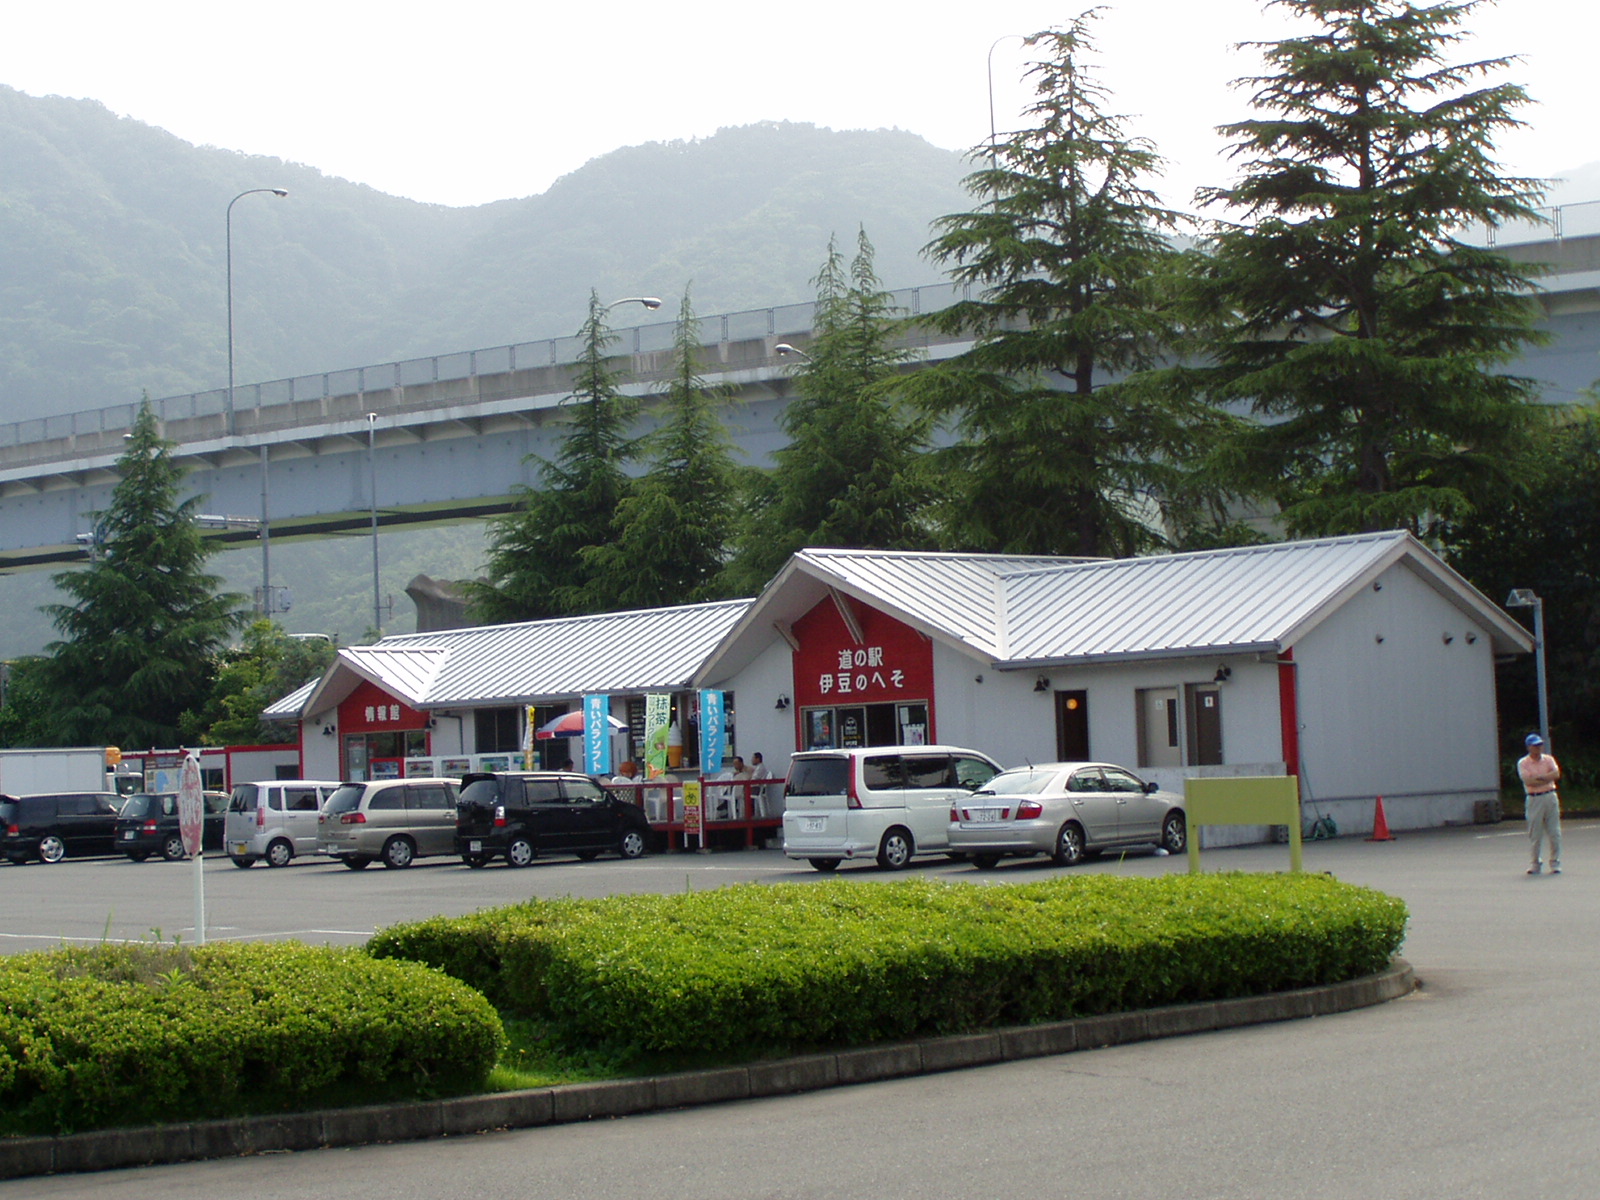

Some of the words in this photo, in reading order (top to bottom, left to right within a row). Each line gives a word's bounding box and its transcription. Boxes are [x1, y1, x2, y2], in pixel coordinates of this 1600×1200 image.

[838, 646, 883, 669] 道の駅
[819, 669, 905, 694] 伊豆のへそ
[655, 697, 668, 725] 抹茶
[590, 698, 603, 772] 青いバラソフト
[706, 693, 719, 771] 青いバラソフト
